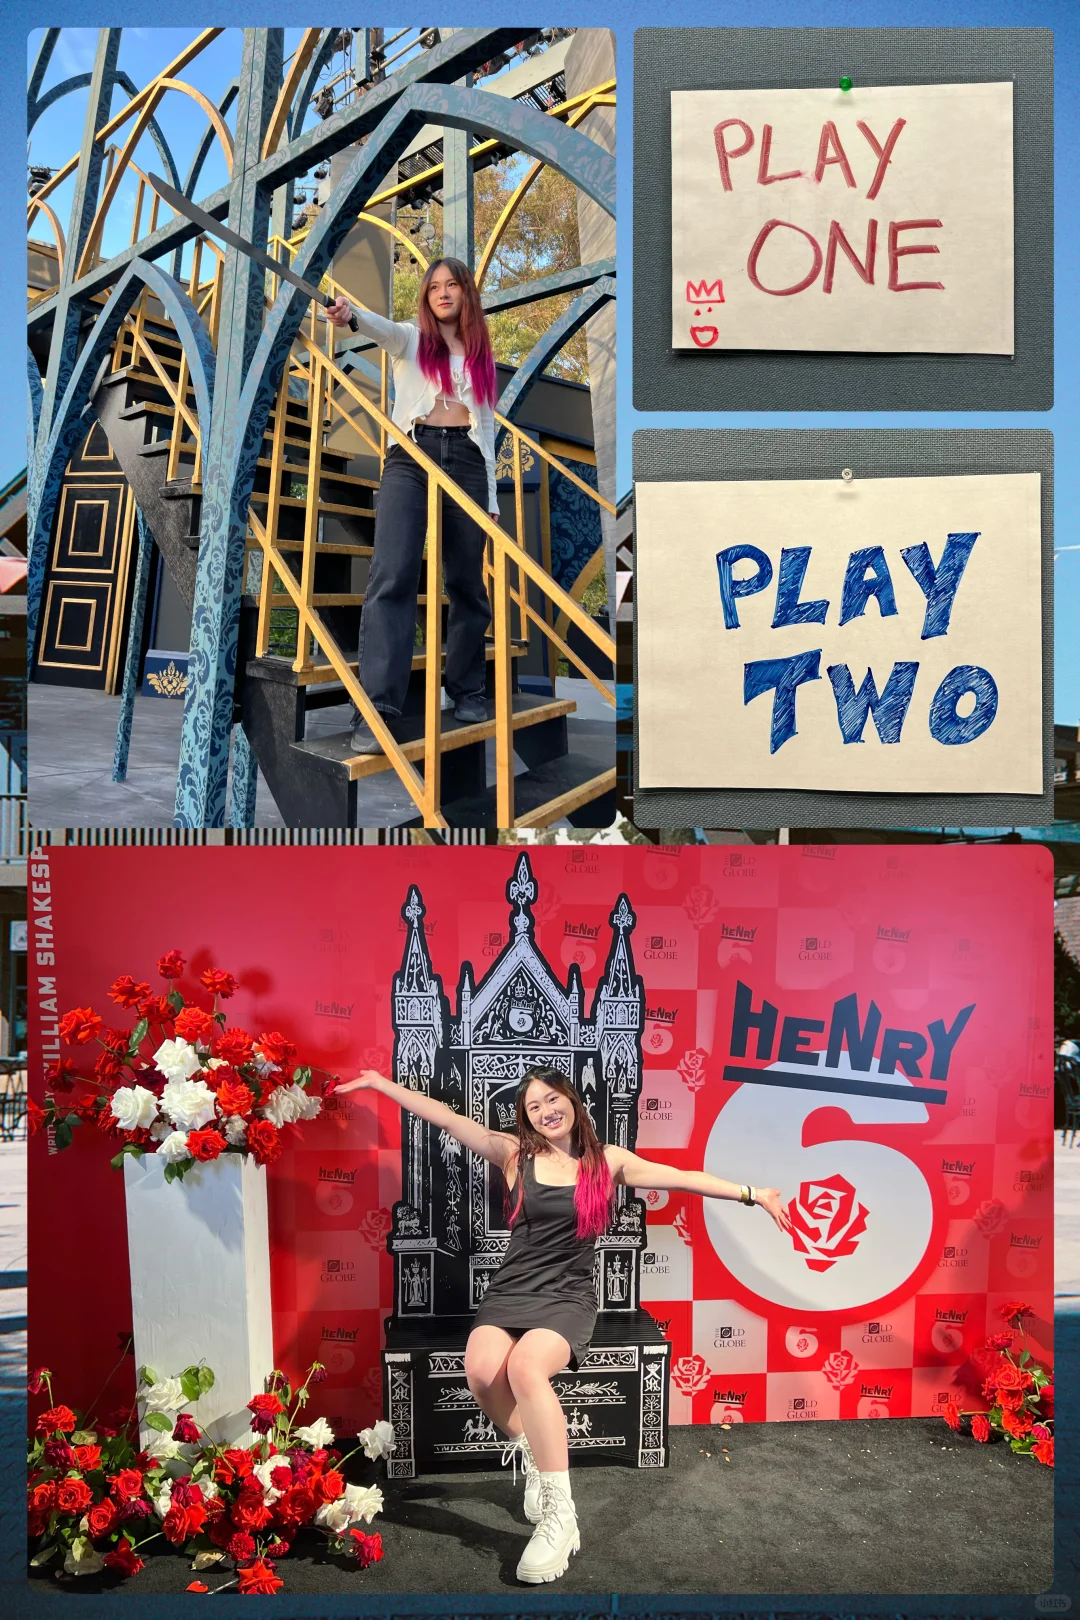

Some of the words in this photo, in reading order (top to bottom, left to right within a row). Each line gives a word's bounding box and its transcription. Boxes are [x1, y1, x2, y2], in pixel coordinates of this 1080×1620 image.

[713, 117, 907, 200] PLAY
[747, 218, 946, 297] ONE
[715, 531, 982, 640] PLAY
[743, 648, 999, 755] TWO
[565, 863, 600, 874] GLOBE
[723, 867, 757, 878] GLOBE
[30, 846, 55, 967] SHAKESP
[398, 916, 438, 932] HRY
[643, 950, 678, 960] GLOBE
[798, 951, 832, 961] GLOBE
[39, 976, 61, 1080] ILLIAM
[729, 980, 976, 1080] HENRY
[640, 1111, 673, 1120] GLOBE
[703, 1049, 933, 1312] 6
[938, 1259, 969, 1268] GLOBE
[640, 1266, 670, 1274] GLOBE
[320, 1273, 356, 1282] GLOBE
[714, 1338, 746, 1348] GLOBE
[862, 1334, 894, 1344] GLOBE
[787, 1410, 819, 1420] GLOBE
